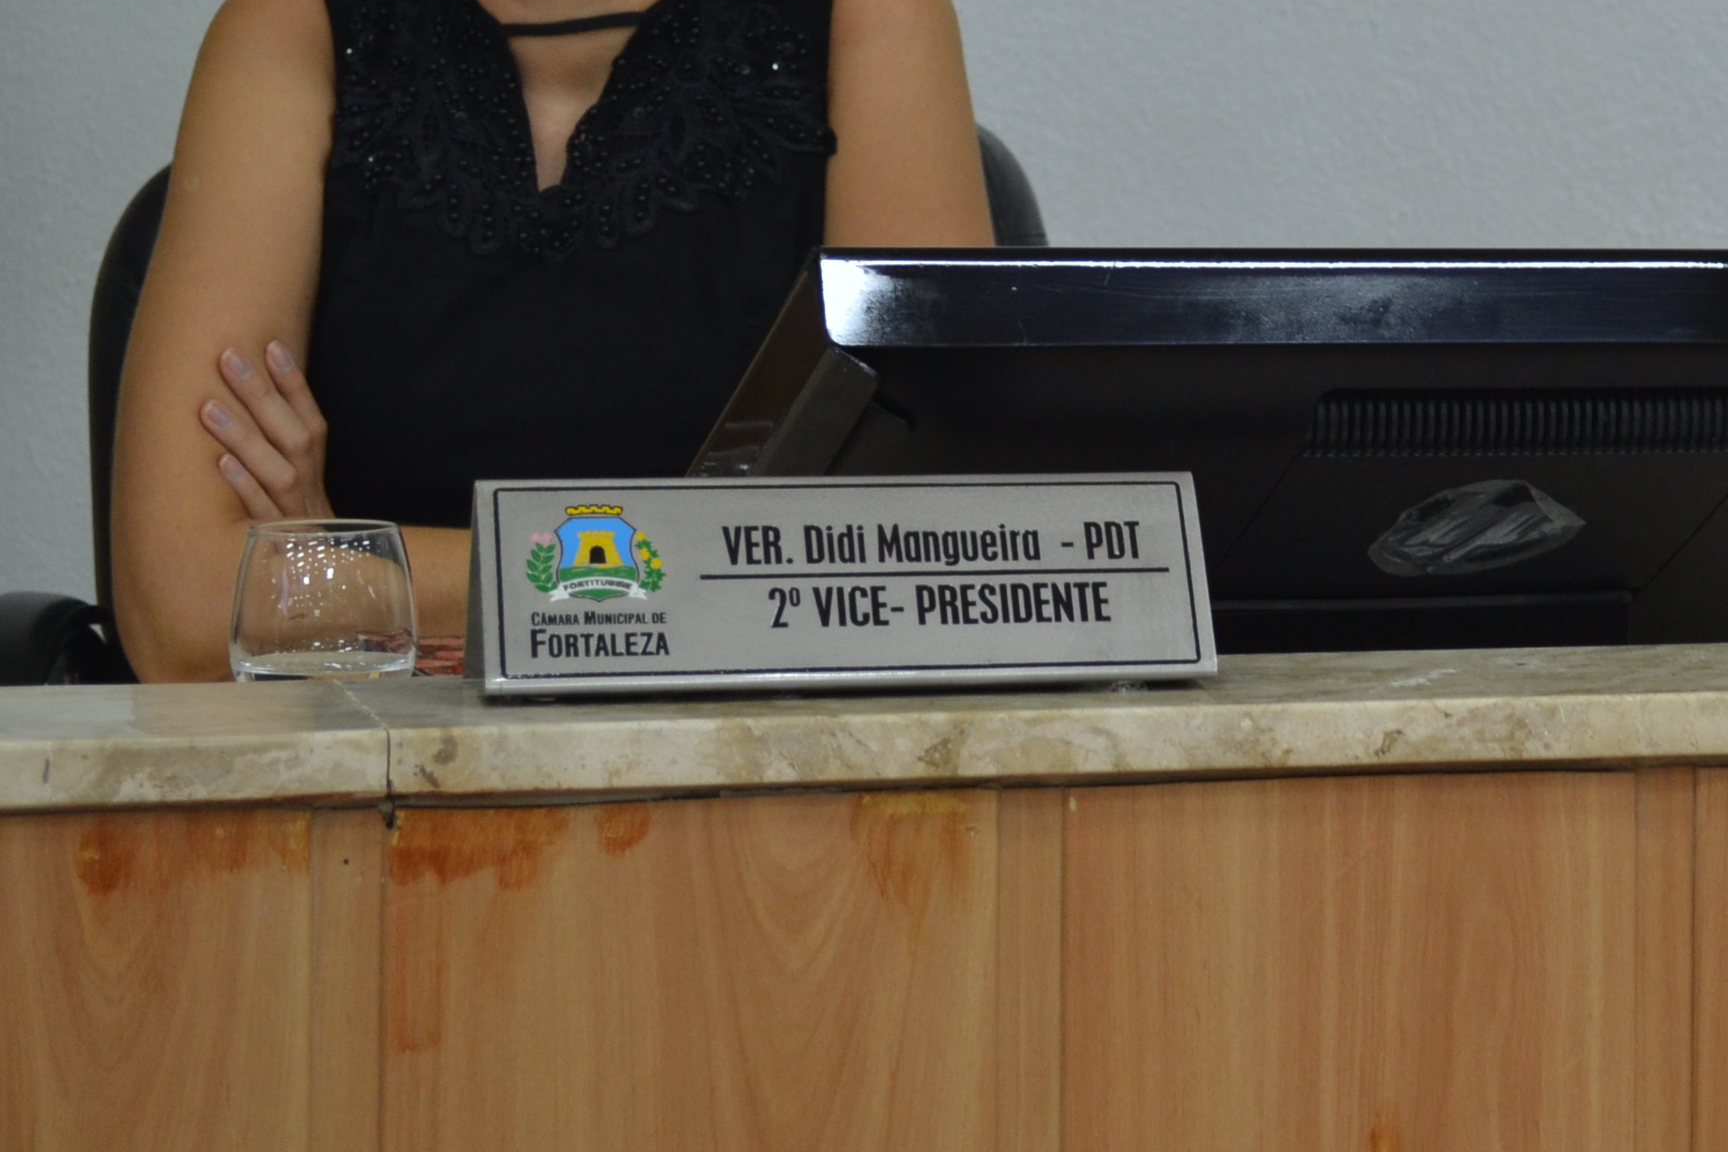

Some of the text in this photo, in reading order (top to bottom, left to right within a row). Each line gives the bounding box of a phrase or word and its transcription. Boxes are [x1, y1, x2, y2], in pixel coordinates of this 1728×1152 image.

[721, 525, 794, 566] VER.
[803, 524, 867, 564] Didi
[877, 523, 1041, 567] Mangueira
[1083, 520, 1140, 560] PDT
[651, 612, 668, 624] DE
[915, 581, 1112, 626] PRESIDENTE
[530, 628, 671, 659] FORTALEZA
